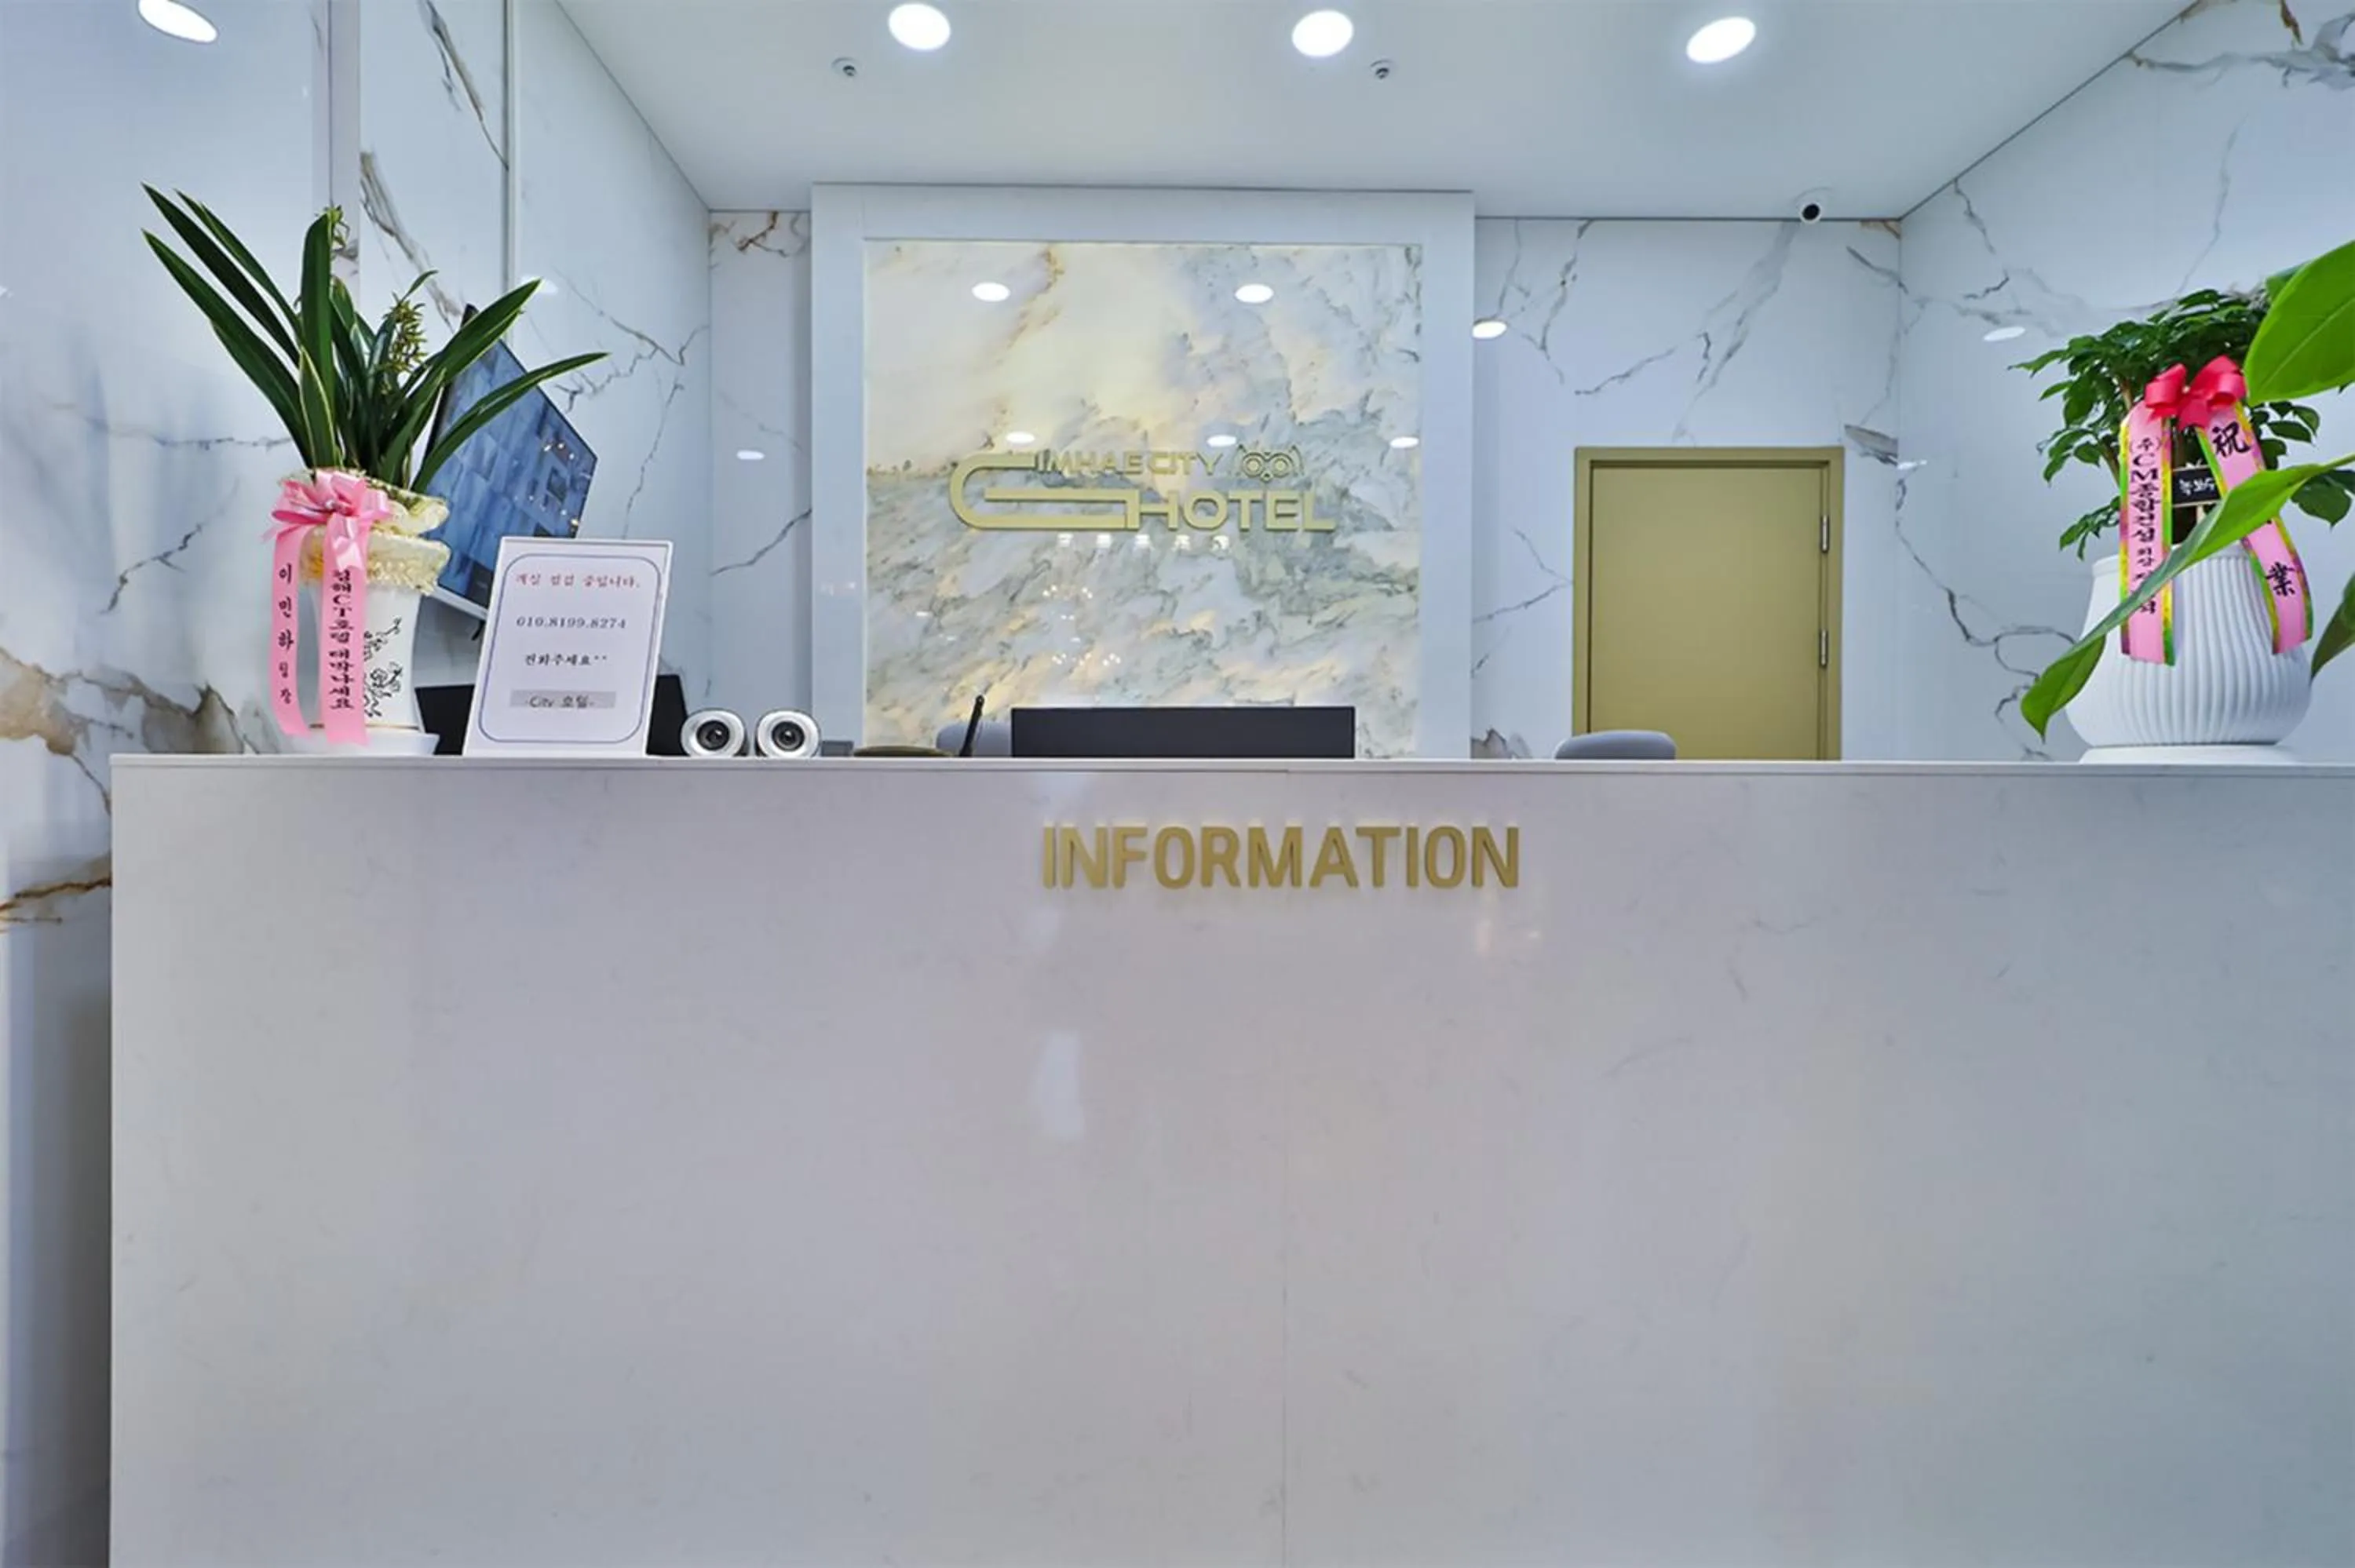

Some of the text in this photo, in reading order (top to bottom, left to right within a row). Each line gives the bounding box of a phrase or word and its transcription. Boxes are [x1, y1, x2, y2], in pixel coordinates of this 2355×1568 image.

[1147, 450, 1223, 472] CITY
[1127, 490, 1335, 531] HOTEL
[516, 616, 626, 629] 010.8199.8274
[1042, 825, 1521, 889] INFORMATION
